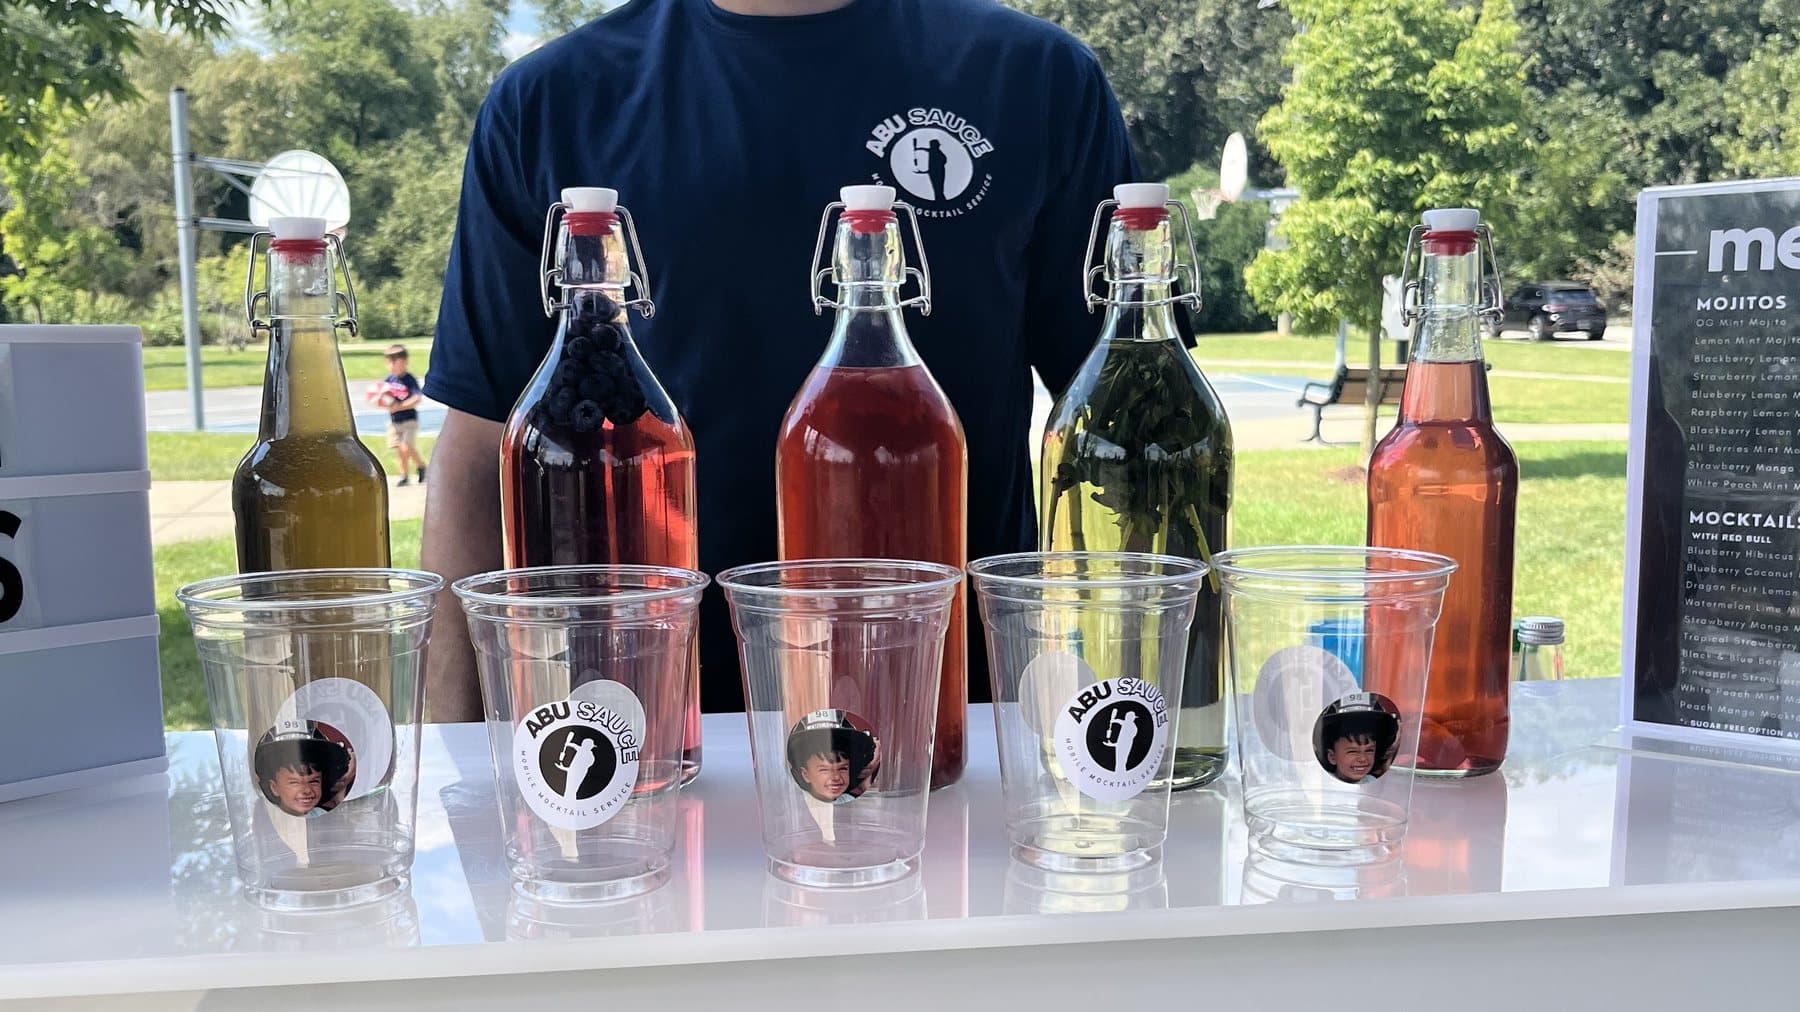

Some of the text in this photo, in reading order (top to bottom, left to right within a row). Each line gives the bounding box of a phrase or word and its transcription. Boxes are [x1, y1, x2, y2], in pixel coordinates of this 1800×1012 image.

[866, 108, 994, 158] ABU SAUCE
[966, 173, 993, 210] SERVICE
[1696, 295, 1786, 311] MOJITOS
[1696, 318, 1786, 328] OG Mint Mojito
[1695, 337, 1730, 345] Lemon
[1736, 337, 1760, 345] Mint
[1694, 354, 1796, 364] Blackberry Lemon
[1693, 372, 1798, 382] Strawberry Lemon
[1692, 390, 1746, 400] Blueberry
[1752, 391, 1787, 399] Lemon
[1691, 408, 1748, 418] Raspberry
[1753, 409, 1790, 417] Lemon
[1690, 426, 1750, 437] Blackberry
[1756, 428, 1791, 436] Lemon
[1690, 443, 1703, 452] All
[1708, 444, 1748, 453] Berries
[1753, 445, 1778, 454] Mint
[1688, 461, 1794, 474] Strawberry Mango
[1687, 479, 1718, 488] White
[1724, 480, 1758, 489] Peach
[1763, 482, 1787, 490] Mint
[1690, 510, 1800, 529] MOCKTAIL
[1692, 532, 1772, 543] WITH RED BULL
[1688, 546, 1740, 558] Blueberry
[1746, 550, 1793, 560] Hibiscus
[1686, 564, 1740, 576] Blueberry
[1744, 568, 1792, 578] Coconut
[1686, 581, 1798, 597] Dragon Fruit Lemon
[1685, 598, 1750, 610] Watermelon
[1756, 602, 1780, 613] Lime
[1683, 616, 1746, 629] Strawberry
[1750, 621, 1788, 633] Mango
[1684, 632, 1797, 650] Tropical Strawberry
[1682, 648, 1710, 659] Black
[1717, 652, 1724, 660] &
[1730, 653, 1754, 664] Blue
[1759, 656, 1787, 670] Berry
[1681, 666, 1738, 680] Pineapple
[1681, 684, 1711, 694] White
[1716, 687, 1750, 698] Peach
[1068, 676, 1168, 728] ABU SAUCE
[1680, 701, 1712, 712] Peach
[1718, 706, 1755, 717] Mango
[525, 701, 639, 764] ABU SAUCE
[1690, 720, 1720, 729] SUGAR
[1724, 724, 1744, 732] FREE
[1748, 726, 1783, 736] OPTION
[1066, 738, 1086, 772] MOBILE
[1089, 774, 1136, 788] MOCKTAIL
[521, 750, 632, 816] MOBILE MOCKTAIL SERVICE
